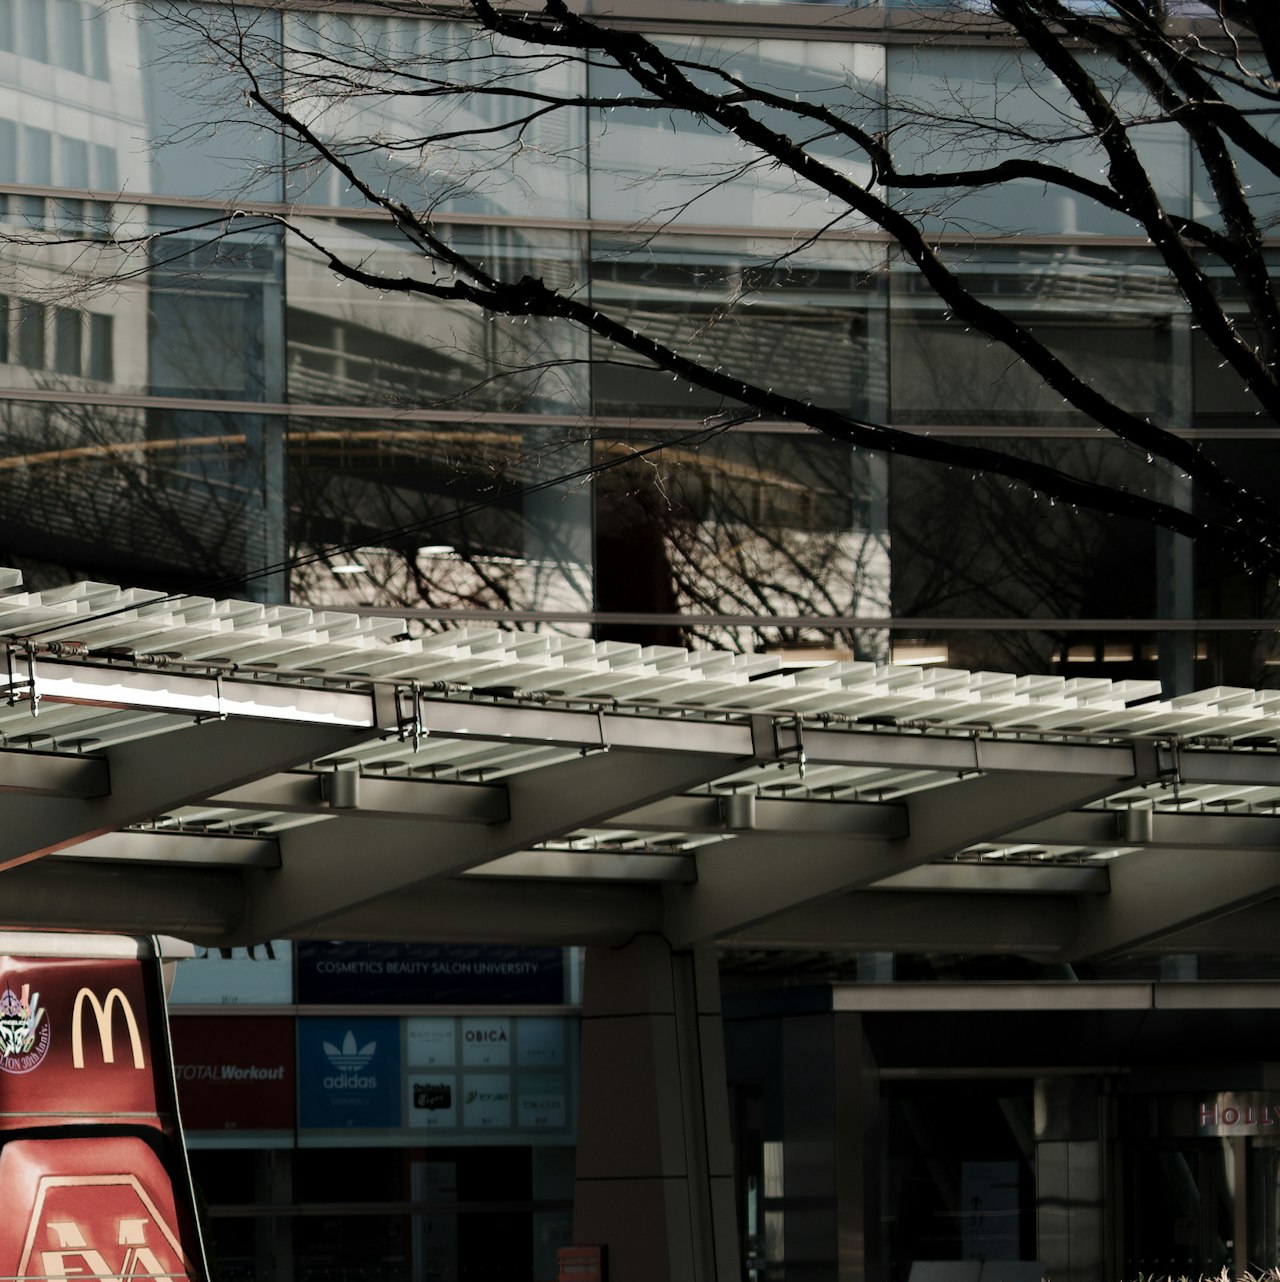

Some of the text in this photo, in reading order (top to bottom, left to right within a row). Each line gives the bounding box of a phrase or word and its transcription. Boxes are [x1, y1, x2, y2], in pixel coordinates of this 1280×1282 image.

[316, 961, 538, 975] COSMETICS BEAUTY SALON UNIVERSITY
[21, 1052, 40, 1070] 30th
[35, 1023, 49, 1056] Anniv.
[323, 1074, 377, 1089] adidas
